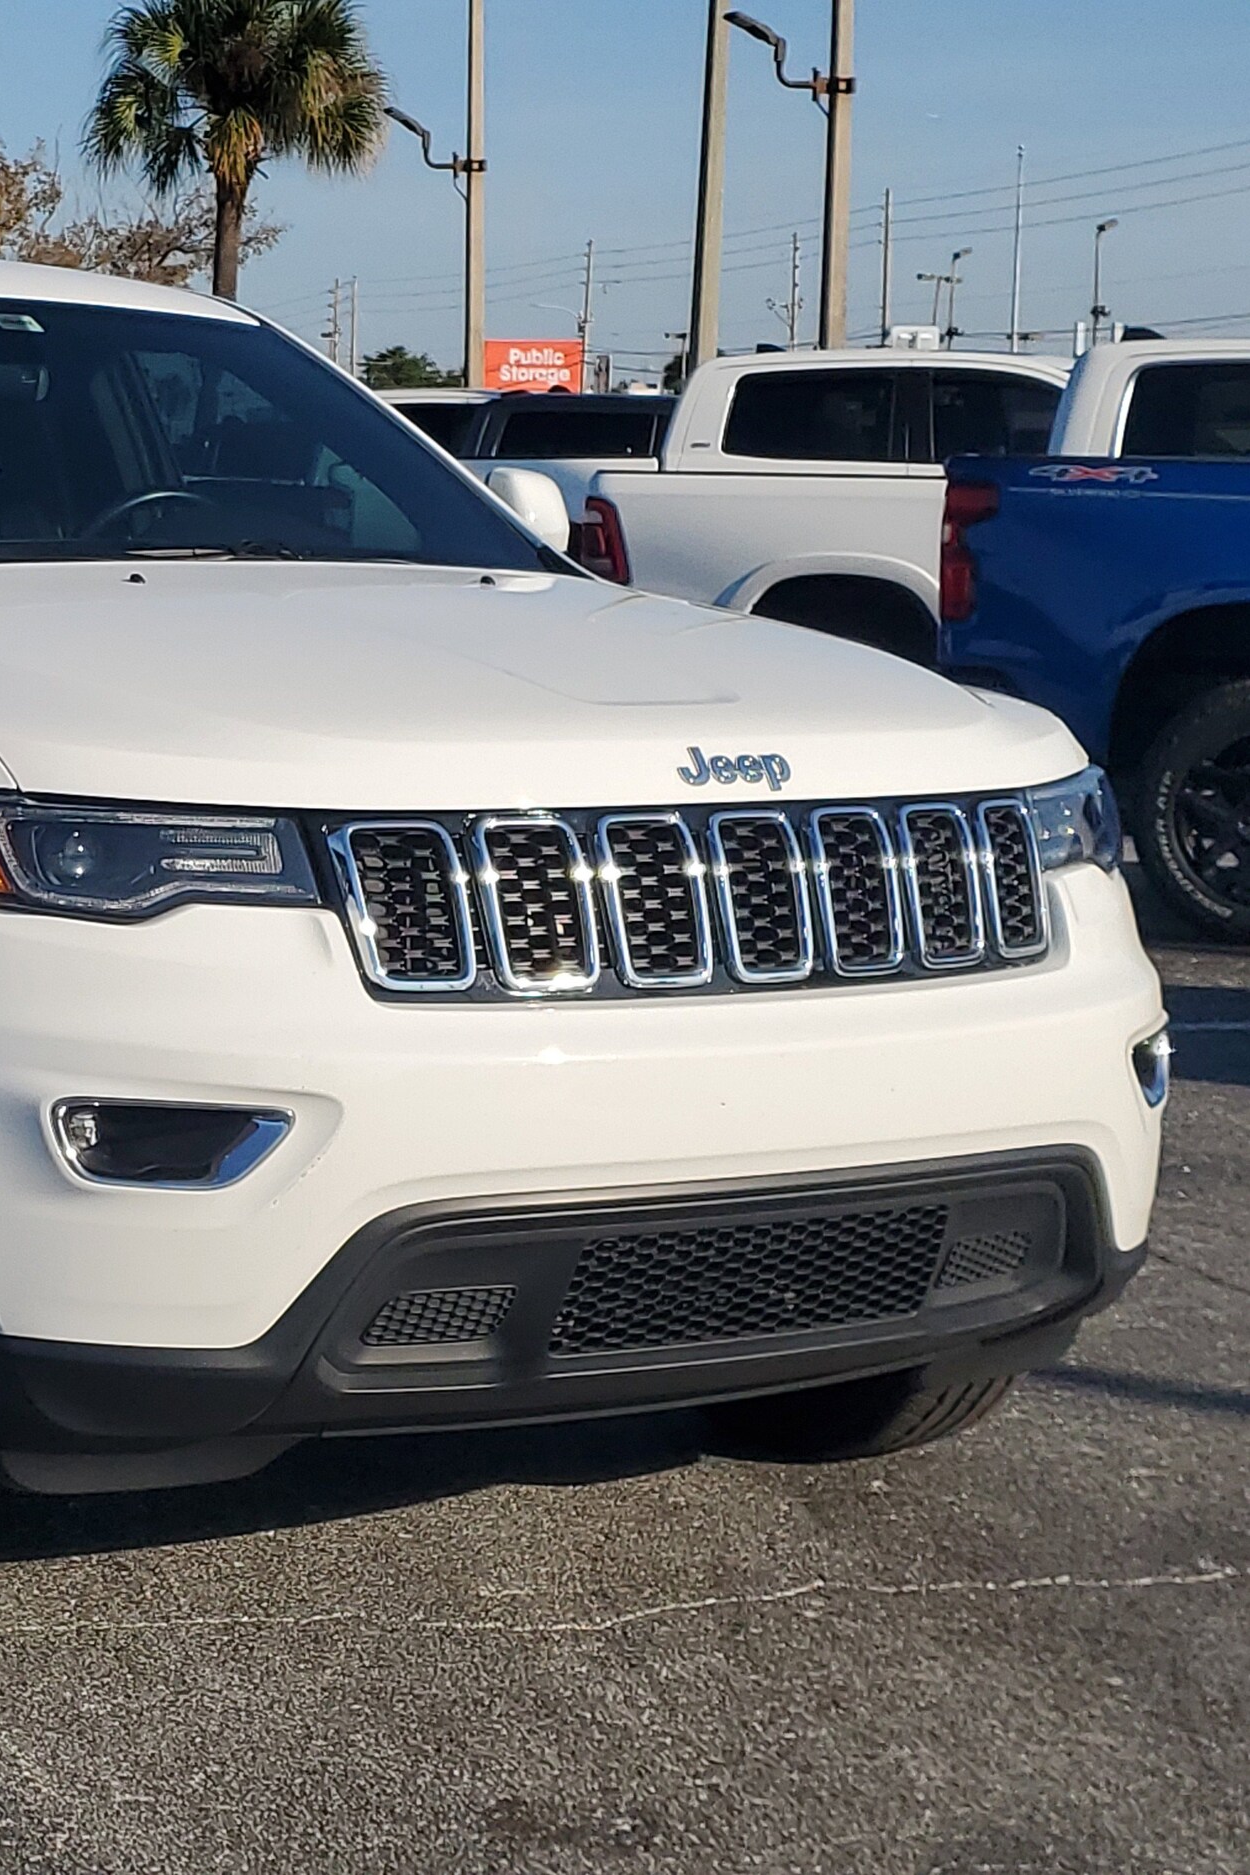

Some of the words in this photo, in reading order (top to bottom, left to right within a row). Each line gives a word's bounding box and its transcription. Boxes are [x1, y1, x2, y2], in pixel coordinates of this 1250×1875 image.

[509, 347, 565, 365] Public
[499, 364, 571, 385] Storage
[676, 746, 791, 791] Jeep
